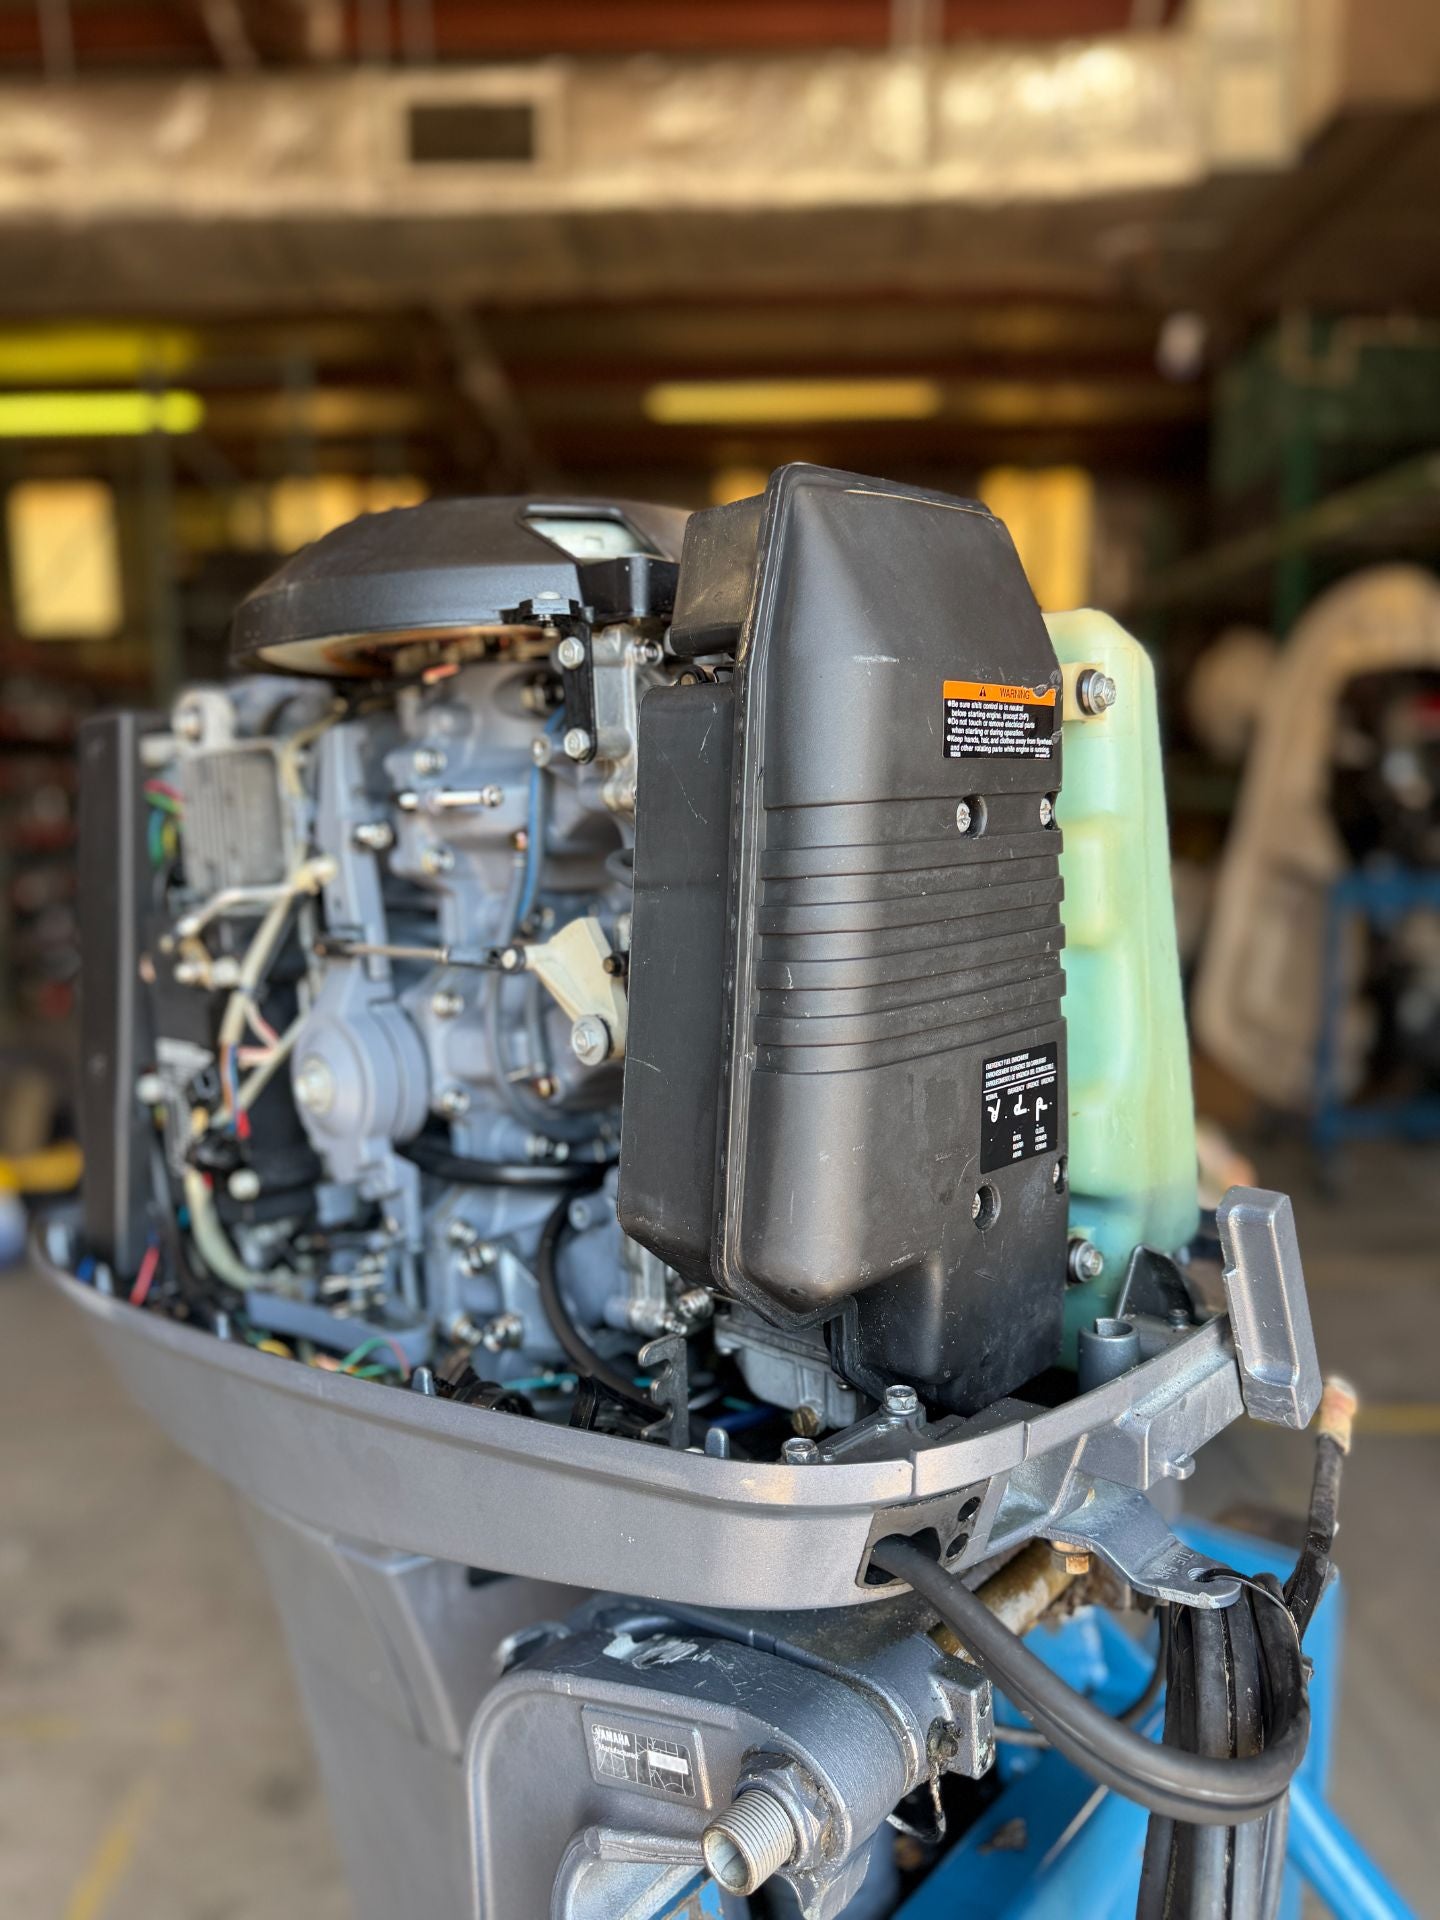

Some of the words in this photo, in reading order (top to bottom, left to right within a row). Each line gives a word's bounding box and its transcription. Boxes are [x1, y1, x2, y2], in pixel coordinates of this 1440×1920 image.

[1000, 688, 1029, 699] WARNING
[952, 709, 967, 717] before
[968, 710, 985, 719] starting
[986, 711, 1002, 720] engine.
[952, 717, 958, 725] Do
[965, 727, 983, 736] starting
[990, 728, 1003, 737] during
[951, 735, 963, 743] Keep
[964, 736, 980, 744] hands,
[1015, 738, 1026, 747] away
[974, 745, 991, 753] rotating
[986, 1060, 1003, 1070] EMERGENCY
[595, 1727, 630, 1746] YAMAHA
